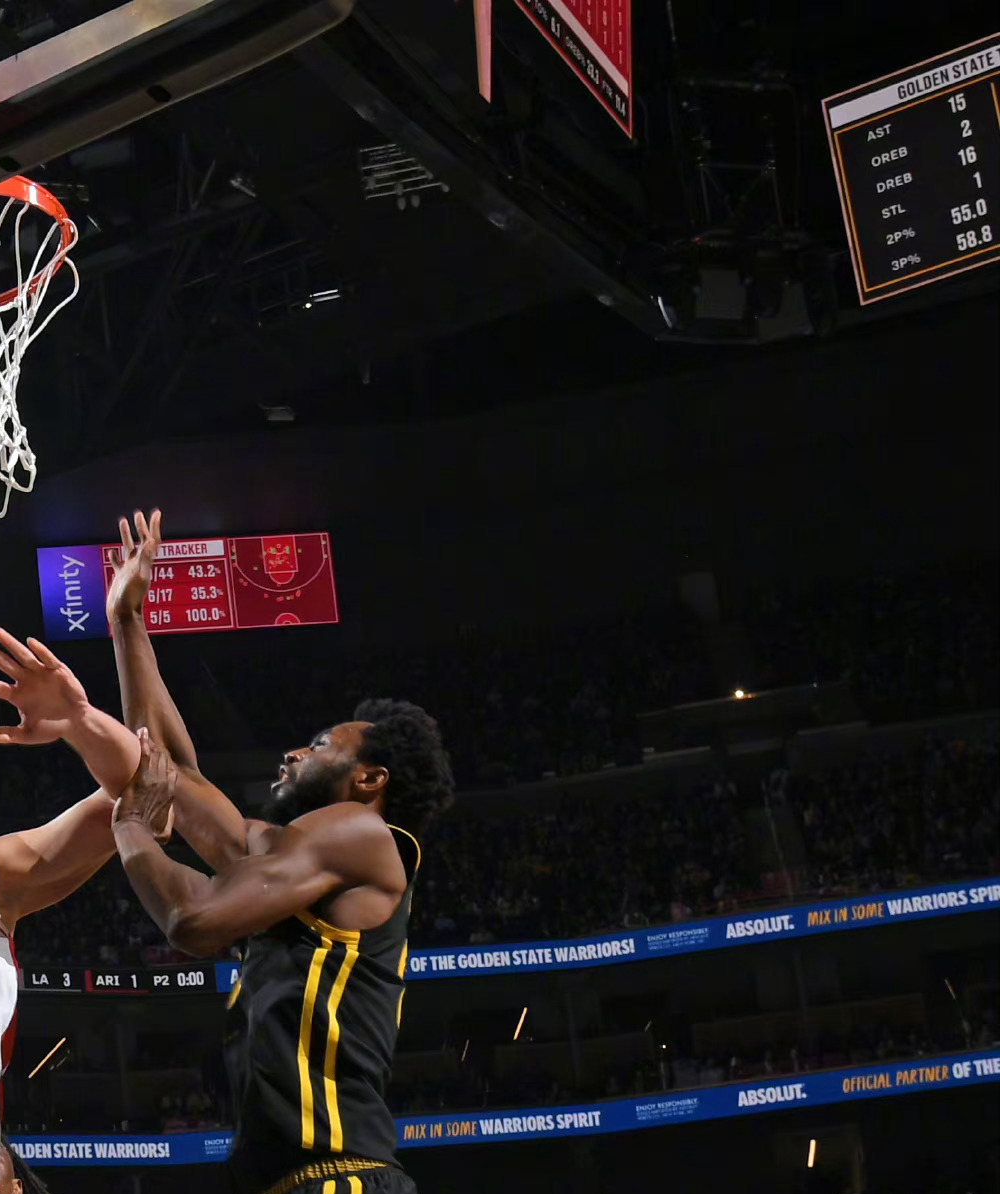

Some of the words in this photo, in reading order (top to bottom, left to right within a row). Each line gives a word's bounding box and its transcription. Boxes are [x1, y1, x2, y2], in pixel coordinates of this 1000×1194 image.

[897, 67, 950, 100] GOLDEN
[952, 51, 995, 80] STATE
[947, 93, 967, 113] 15
[866, 123, 892, 142] AST
[960, 119, 973, 138] 2
[870, 146, 909, 168] OREB
[957, 145, 978, 167] 16
[876, 172, 913, 194] DREB
[972, 171, 983, 189] 1
[881, 203, 907, 219] STL
[950, 198, 988, 225] 55.0
[885, 226, 917, 246] 2P%
[955, 224, 993, 252] 58.8
[890, 253, 922, 272] 3P%
[161, 543, 208, 557] TRACKER
[58, 554, 90, 632] xfinity
[149, 611, 171, 626] 5/5
[807, 910, 832, 928] MIX
[833, 907, 849, 924] IN
[851, 902, 885, 921] SOME
[887, 890, 968, 916] WARRIORS
[726, 914, 796, 940] ABSOLUT.
[410, 956, 428, 972] OF
[429, 954, 456, 971] THE
[457, 951, 511, 969] GOLDEN
[512, 948, 553, 966] STATE
[553, 938, 636, 963] WARRIORS!
[32, 973, 49, 985] LA
[62, 972, 71, 988] 3
[96, 975, 120, 987] ARI
[130, 974, 138, 989] 1
[153, 974, 170, 987] P2
[176, 971, 205, 987] 0:00
[842, 1072, 892, 1094] OFFICIAL
[896, 1065, 949, 1086] PARTNER
[952, 1061, 972, 1079] OF
[973, 1058, 1000, 1076] THE
[738, 1083, 807, 1107] ABSOLUT.
[404, 1124, 427, 1141] MIX
[429, 1122, 443, 1139] IN
[446, 1121, 478, 1138] SOME
[479, 1114, 555, 1136] WARRIORS
[556, 1111, 601, 1129] SPIRIT
[10, 1143, 51, 1159] OLDEN
[53, 1143, 92, 1159] STATE
[93, 1142, 170, 1159] WARRIORS!
